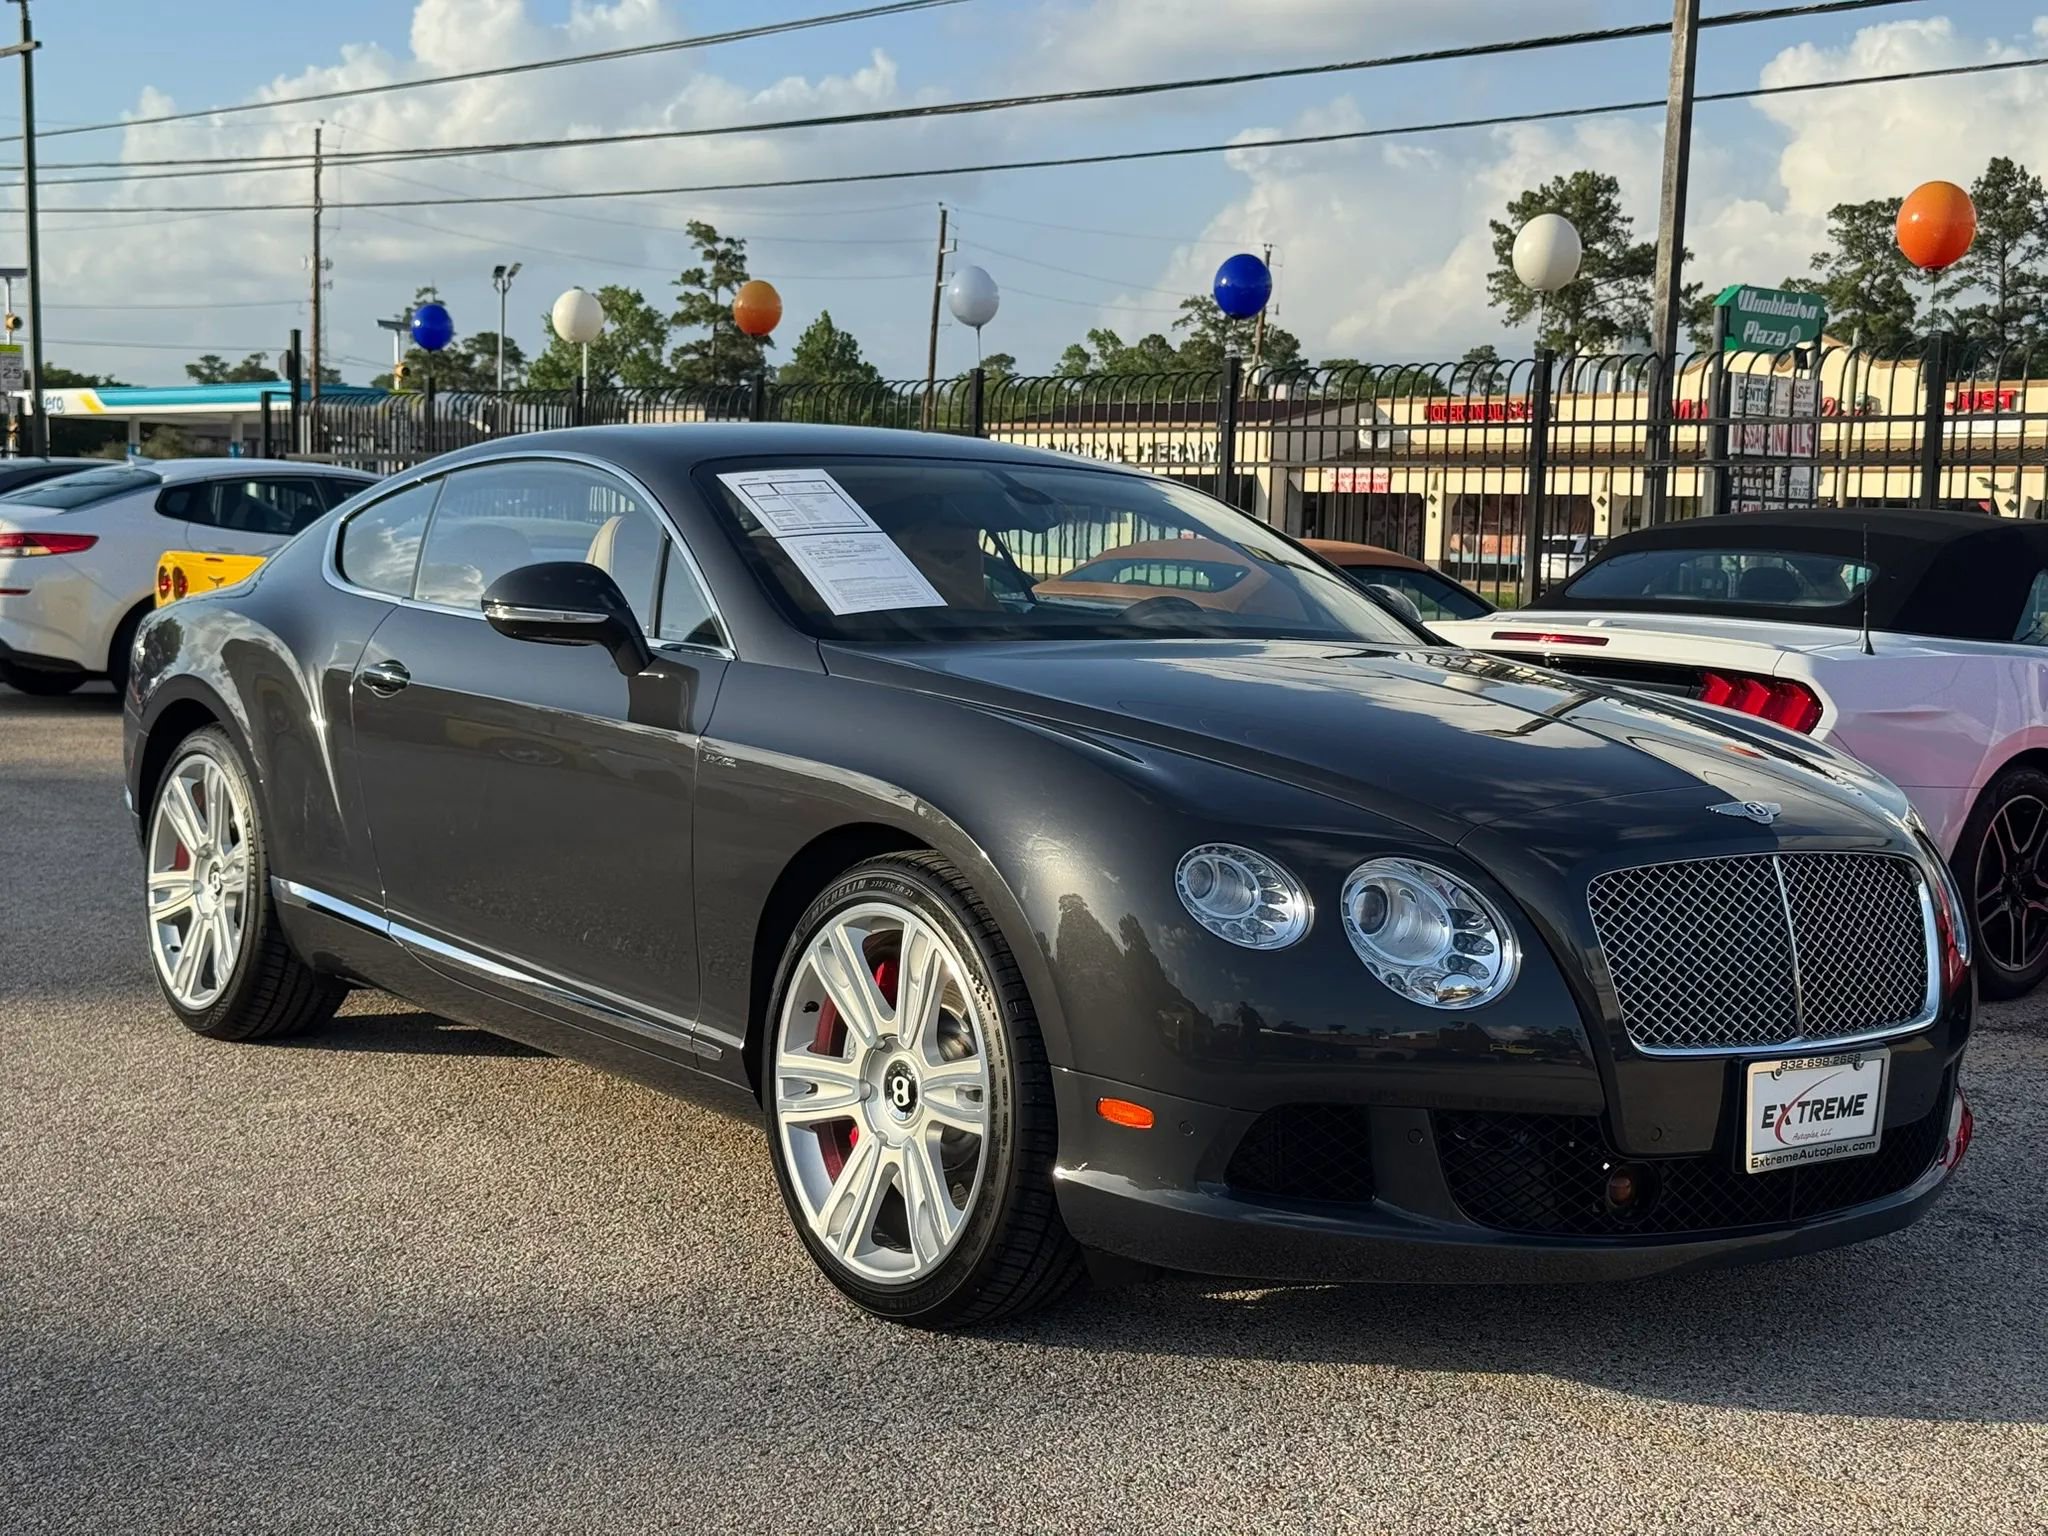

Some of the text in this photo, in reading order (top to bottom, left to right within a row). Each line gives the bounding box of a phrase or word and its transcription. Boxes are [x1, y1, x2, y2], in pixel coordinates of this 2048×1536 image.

[1738, 290, 1817, 320] Wimbledon
[1743, 320, 1787, 347] Plaza
[1738, 386, 1774, 402] DNTIS
[1775, 423, 1814, 454] NILS
[810, 879, 867, 920] MICHELIN
[1761, 1093, 1868, 1129] EXTREME
[1751, 1140, 1876, 1169] ExtremeAutoplex.com
